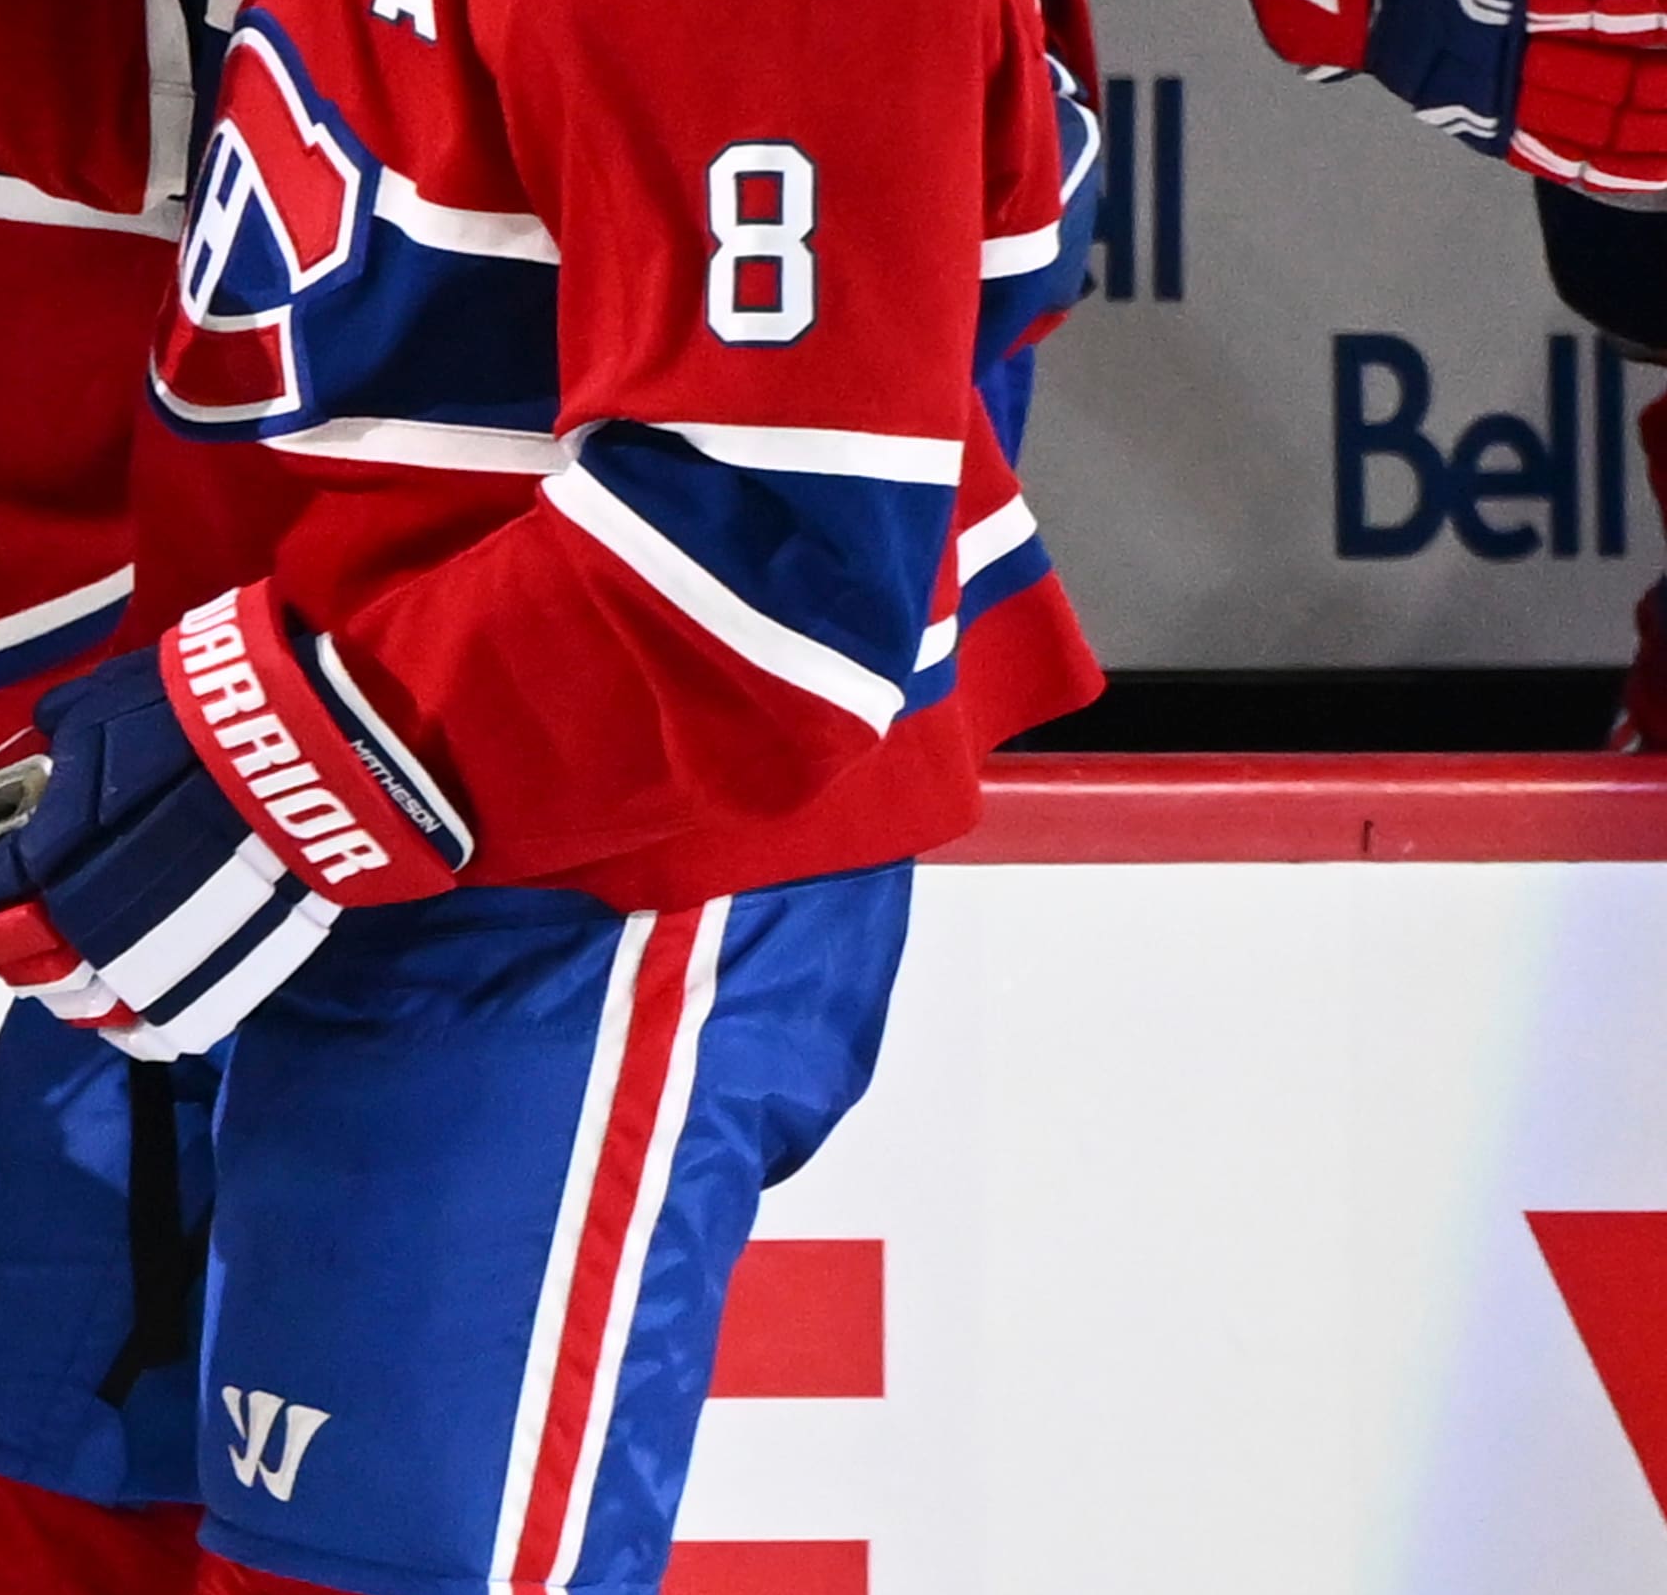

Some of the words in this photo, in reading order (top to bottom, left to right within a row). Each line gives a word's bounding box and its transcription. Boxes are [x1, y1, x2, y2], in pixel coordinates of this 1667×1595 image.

[703, 139, 819, 347] 8
[1332, 332, 1627, 562] Bell
[348, 737, 444, 835] MATHESON
